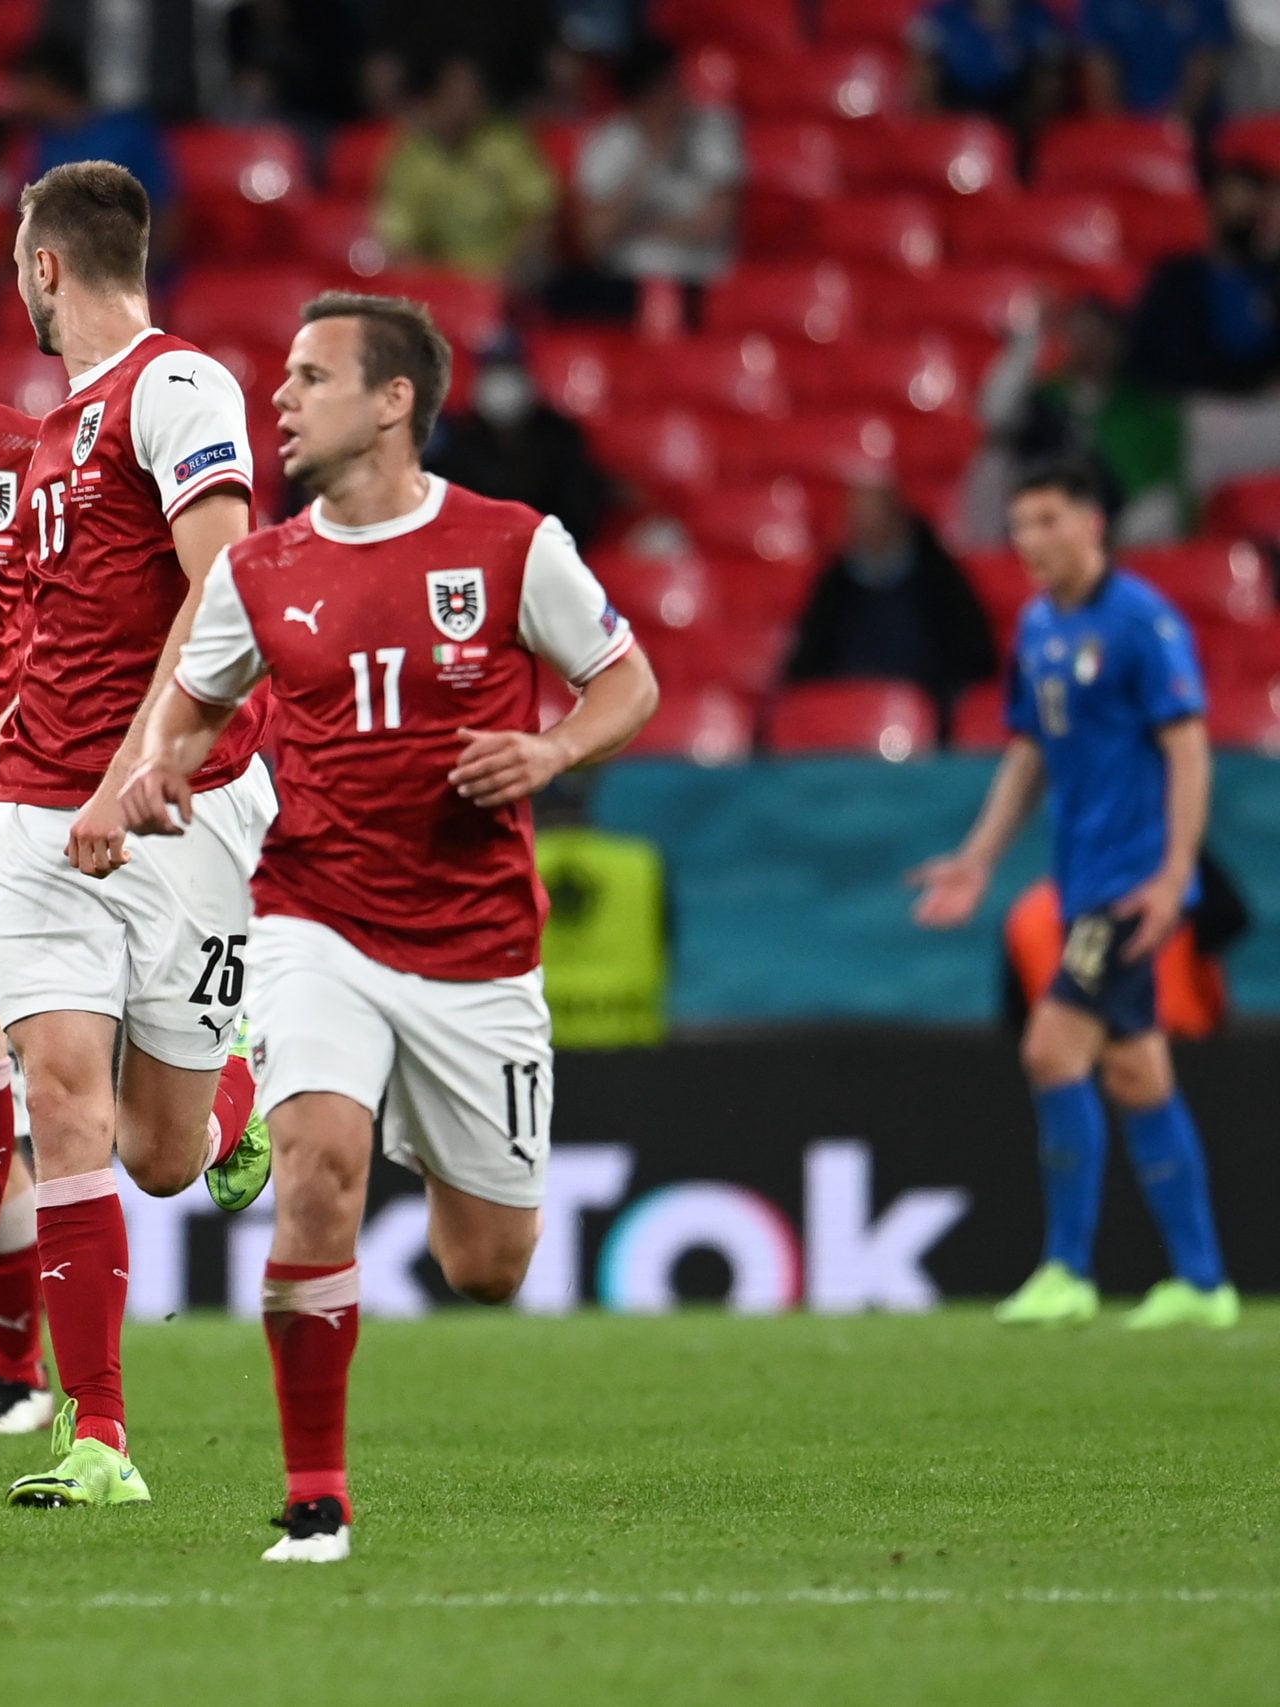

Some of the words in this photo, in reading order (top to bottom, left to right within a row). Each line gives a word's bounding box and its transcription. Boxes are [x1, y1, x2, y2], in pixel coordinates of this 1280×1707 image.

[189, 446, 234, 471] RESPECT
[31, 481, 66, 561] 25
[349, 647, 407, 732] 17
[188, 935, 247, 1007] 25
